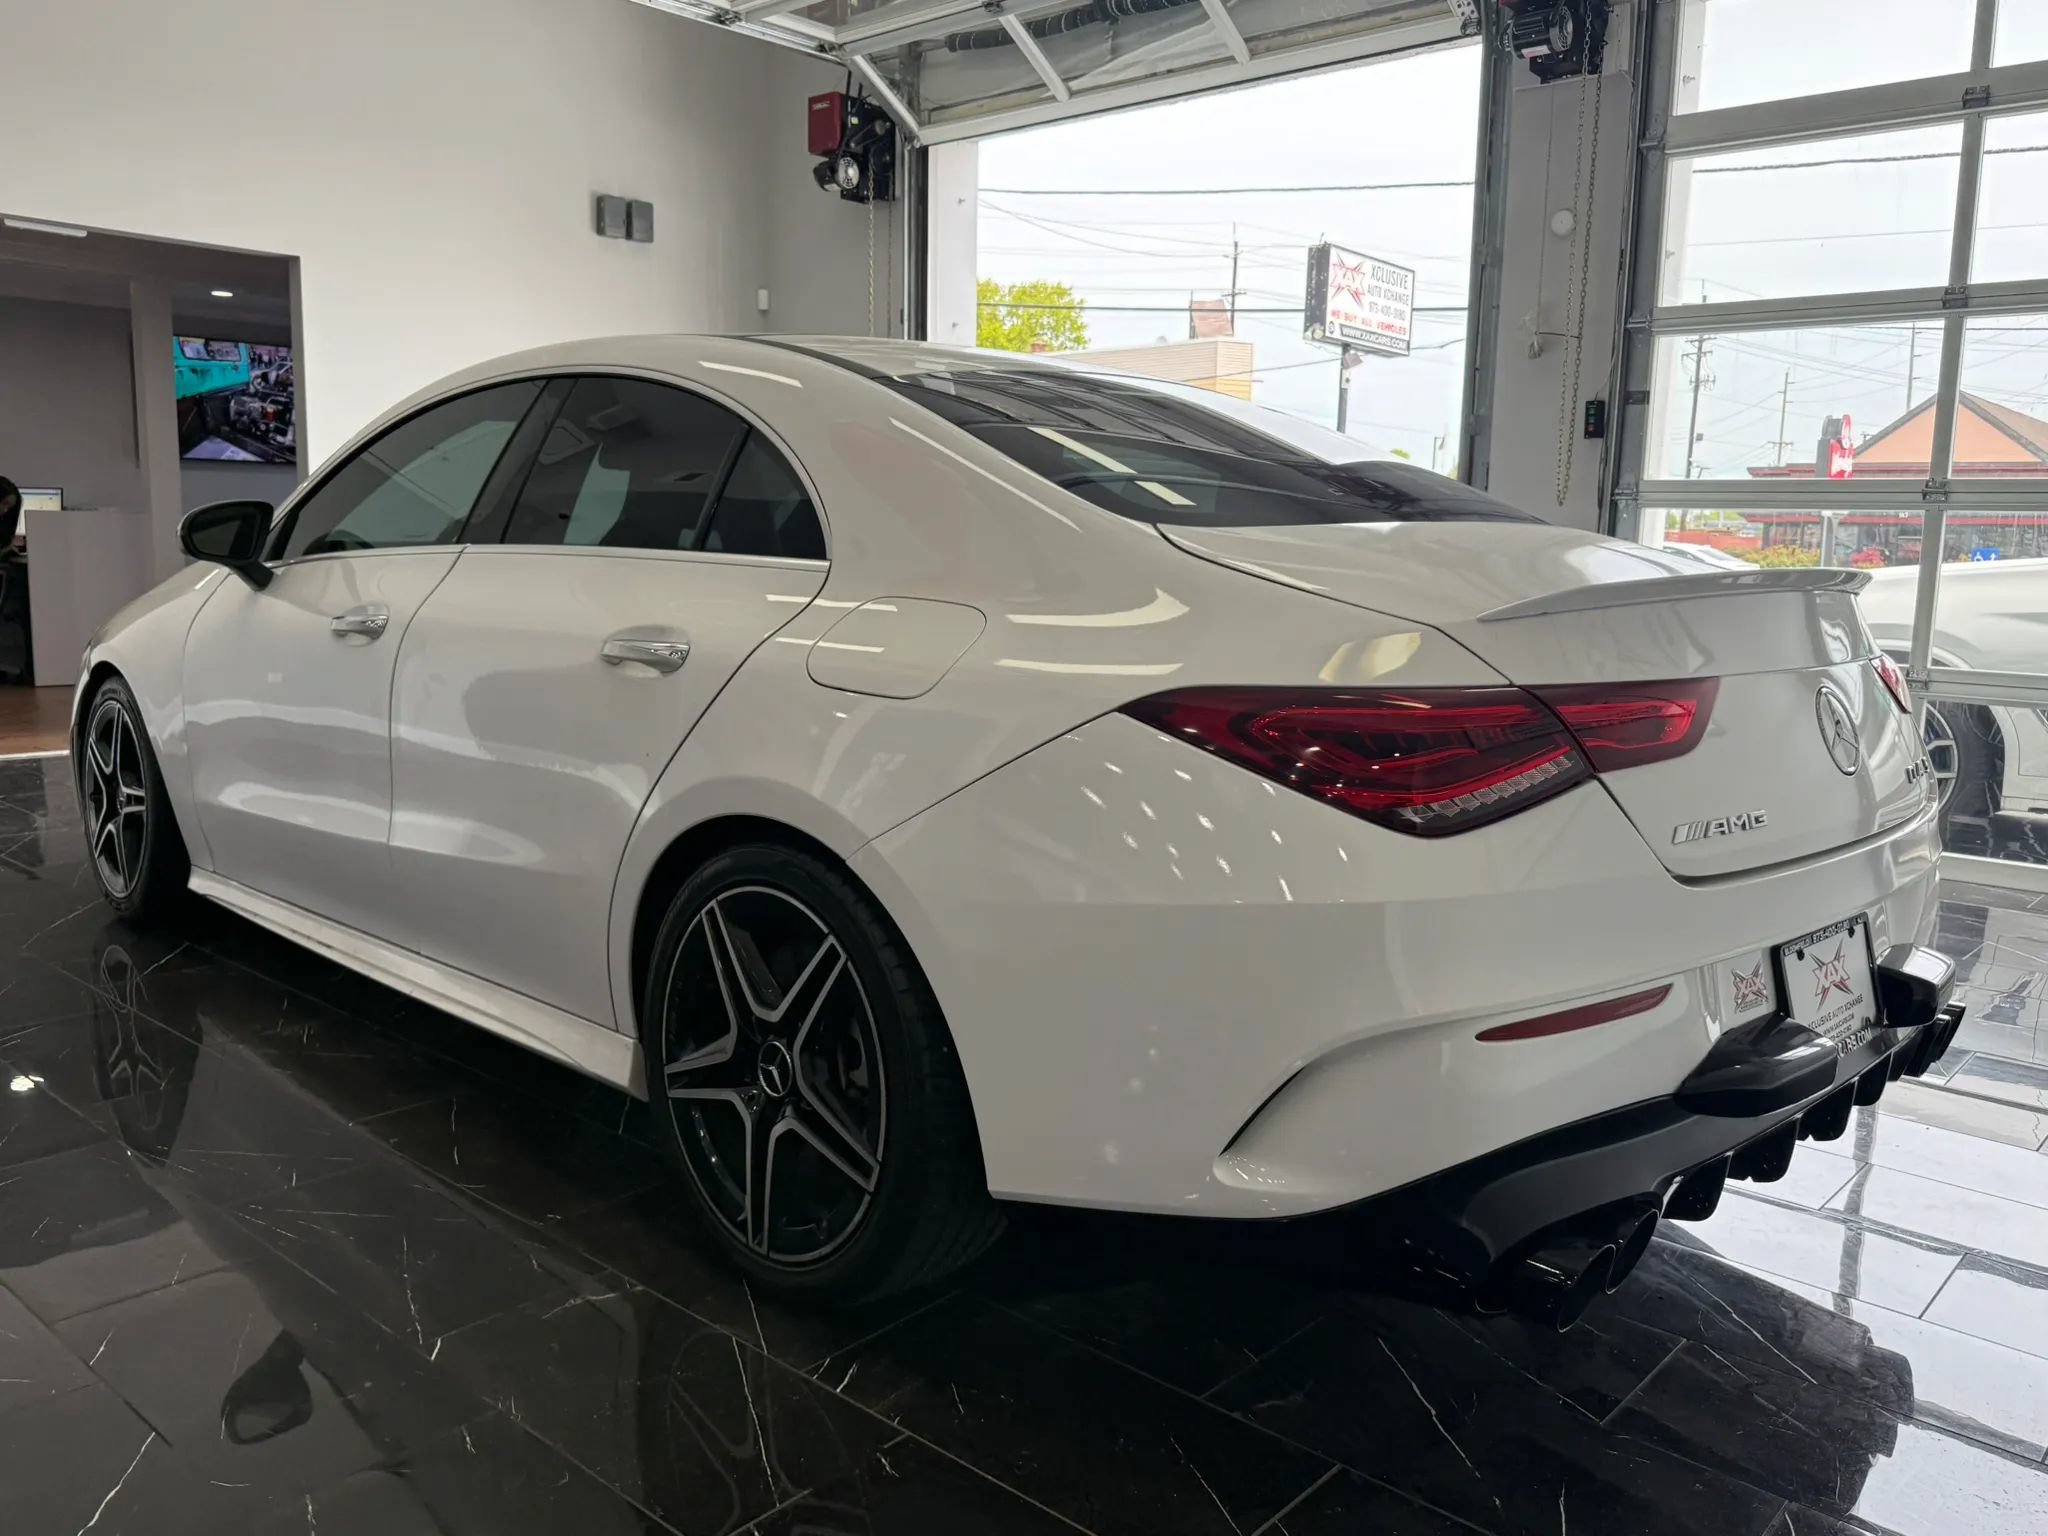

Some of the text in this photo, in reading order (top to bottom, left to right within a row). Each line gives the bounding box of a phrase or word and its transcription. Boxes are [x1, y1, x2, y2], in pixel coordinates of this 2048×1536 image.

[1370, 264, 1409, 290] XCLUSIVE
[1367, 283, 1410, 306] AUTO XCHANGE
[1331, 309, 1407, 336] WE BUY ALL VEHICLES
[1708, 810, 1768, 838] AMG
[1832, 1004, 1844, 1018] AUTO
[1844, 993, 1864, 1012] XCHANGE
